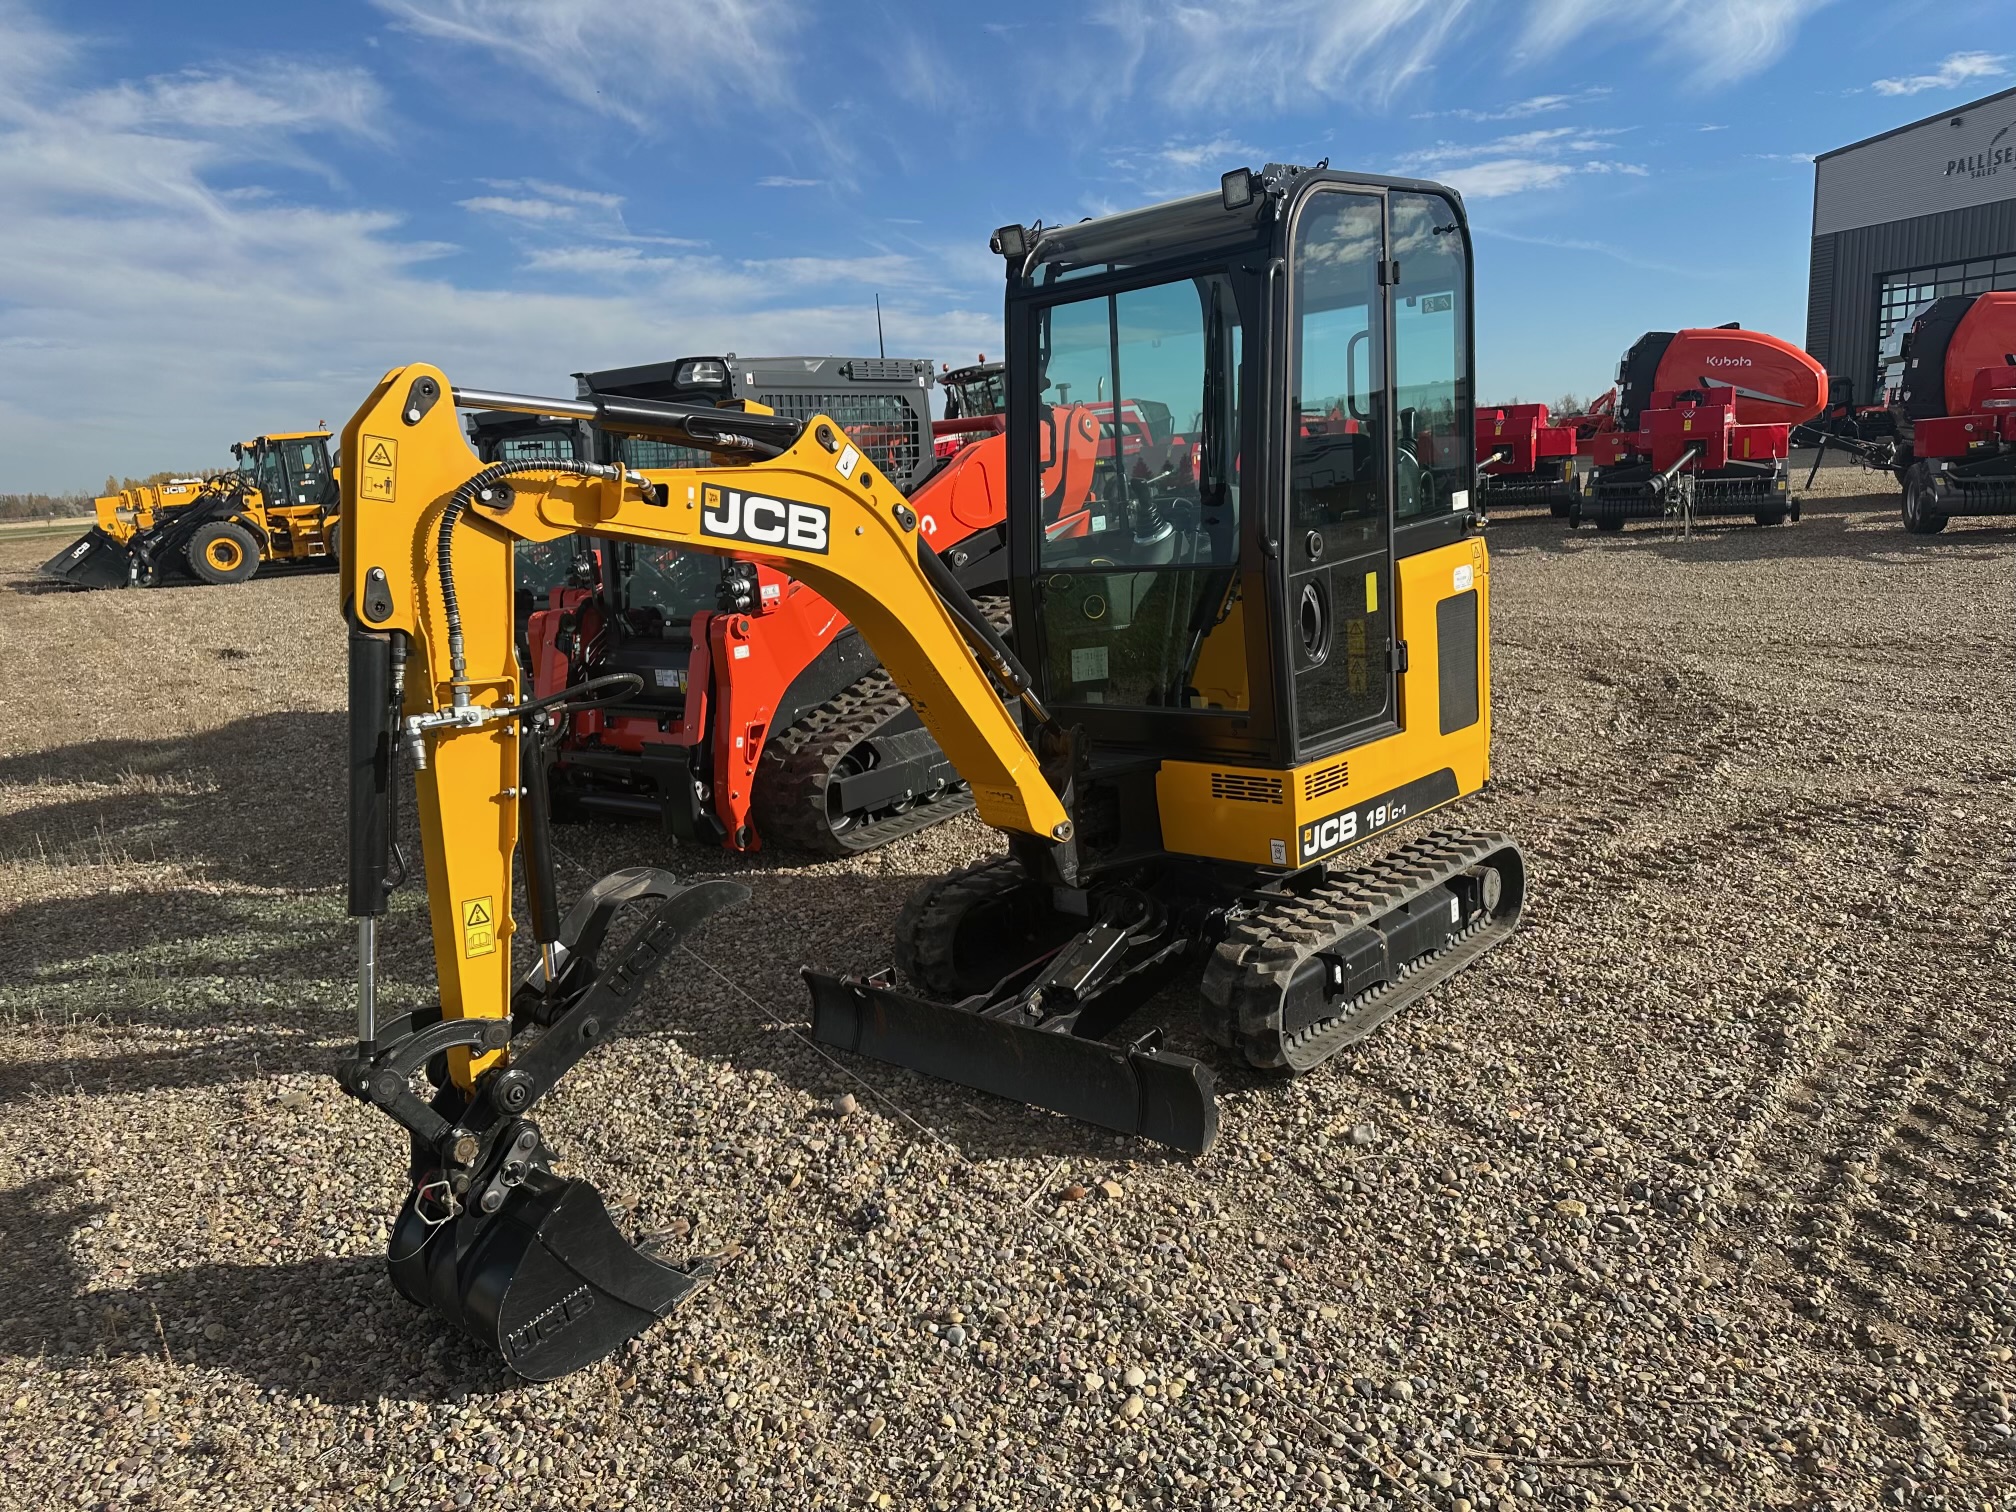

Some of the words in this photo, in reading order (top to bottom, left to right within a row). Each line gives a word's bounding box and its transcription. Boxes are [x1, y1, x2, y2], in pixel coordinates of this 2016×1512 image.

[1946, 147, 2016, 176] PALLISE
[1970, 167, 1997, 179] SALES
[1706, 356, 1752, 367] Kubota
[163, 486, 187, 495] JCB
[704, 492, 828, 550] JCB
[71, 541, 91, 559] JCB
[1304, 811, 1358, 857] JCB
